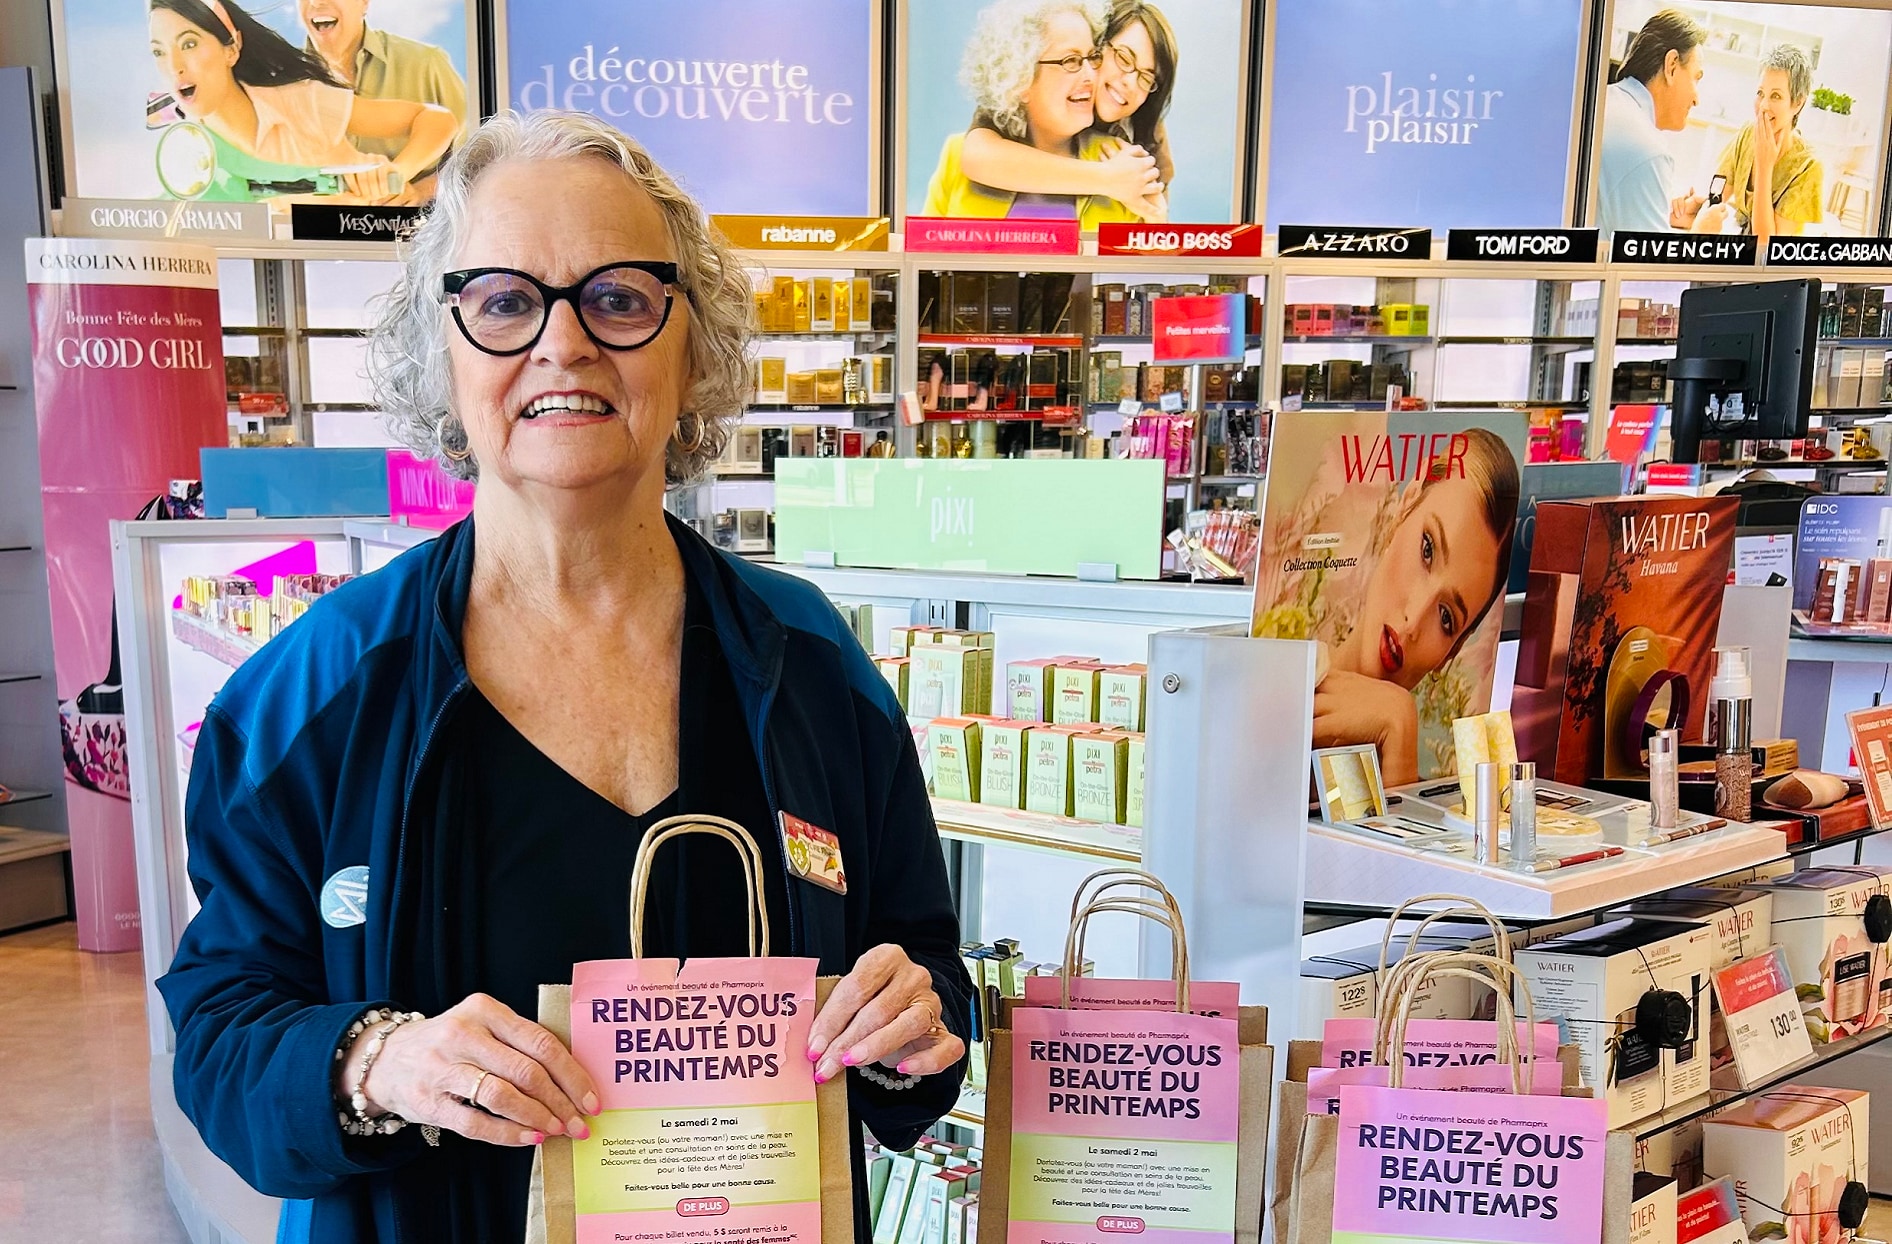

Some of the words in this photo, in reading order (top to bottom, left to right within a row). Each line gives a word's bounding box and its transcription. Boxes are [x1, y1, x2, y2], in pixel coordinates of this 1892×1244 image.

[568, 44, 810, 91] découverte
[1343, 70, 1504, 133] plaisir
[1364, 109, 1479, 154] plaisir
[90, 207, 168, 229] GIORGIO
[175, 208, 243, 231] ARMANI
[760, 225, 837, 244] rabanne
[925, 229, 993, 243] CAROLINA
[995, 230, 1057, 244] HERRERA
[1127, 231, 1181, 250] HUGO
[1182, 231, 1233, 251] BOSS
[1302, 232, 1410, 254] AZZARO
[1475, 235, 1518, 255] TOM
[1521, 235, 1571, 256] FORD
[1622, 239, 1747, 260] GIVENCHY
[39, 253, 137, 271] CAROLINA
[142, 256, 213, 276] HERRERA
[65, 310, 113, 327] Bonne
[117, 309, 147, 327] Fête
[150, 311, 171, 327] des
[1165, 324, 1191, 336] Petites
[56, 336, 144, 370] GOOD
[149, 337, 212, 371] GIRL
[1341, 433, 1470, 484] WATIER
[1817, 503, 1839, 515] IDC
[1621, 511, 1710, 555] WATIER
[1283, 557, 1323, 573] Collection
[1323, 556, 1358, 572] Coquette
[1640, 559, 1678, 577] Havana
[1536, 961, 1575, 973] WATIER
[627, 983, 639, 992] Un
[681, 981, 708, 991] beauté
[709, 981, 720, 990] de
[721, 981, 765, 991] Pharmaprix
[591, 992, 798, 1023] RENDEZ-VOUS
[1069, 996, 1080, 1004] Un
[1080, 997, 1116, 1006] événement
[1117, 998, 1140, 1006] beauté
[1141, 998, 1152, 1006] de
[614, 1019, 728, 1054] BEAUTÉ
[737, 1021, 777, 1050] DU
[1059, 1030, 1070, 1038] Un
[1071, 1030, 1109, 1040] événement
[1110, 1031, 1136, 1040] beauté
[1136, 1031, 1147, 1040] de
[1148, 1032, 1190, 1042] Pharmaprix
[1770, 1012, 1792, 1041] 130
[1030, 1040, 1223, 1067] RENDEZ-VOUS
[614, 1052, 780, 1085] PRINTEMPS
[1048, 1065, 1152, 1092] BEAUTÉ
[1160, 1071, 1201, 1094] DU
[1047, 1092, 1202, 1120] PRINTEMPS
[660, 1118, 672, 1129] Le
[674, 1117, 710, 1128] samedi
[711, 1117, 719, 1127] 2
[719, 1116, 739, 1126] mai
[1396, 1112, 1408, 1121] Un
[1409, 1113, 1455, 1124] événement
[1456, 1115, 1485, 1126] beauté
[1486, 1117, 1498, 1127] de
[1810, 1112, 1850, 1146] WATIER
[1088, 1146, 1099, 1155] Le
[1099, 1147, 1132, 1157] samedi
[1133, 1148, 1140, 1157] 2
[1140, 1148, 1158, 1158] mai
[1358, 1123, 1584, 1160] RENDEZ-VOUS
[1379, 1153, 1503, 1187] BEAUTÉ
[1512, 1162, 1559, 1190] DU
[683, 1202, 696, 1212] DE
[698, 1201, 722, 1211] PLUS
[1377, 1184, 1559, 1221] PRINTEMPS
[1103, 1220, 1115, 1229] DE
[1116, 1220, 1139, 1230] PLUS
